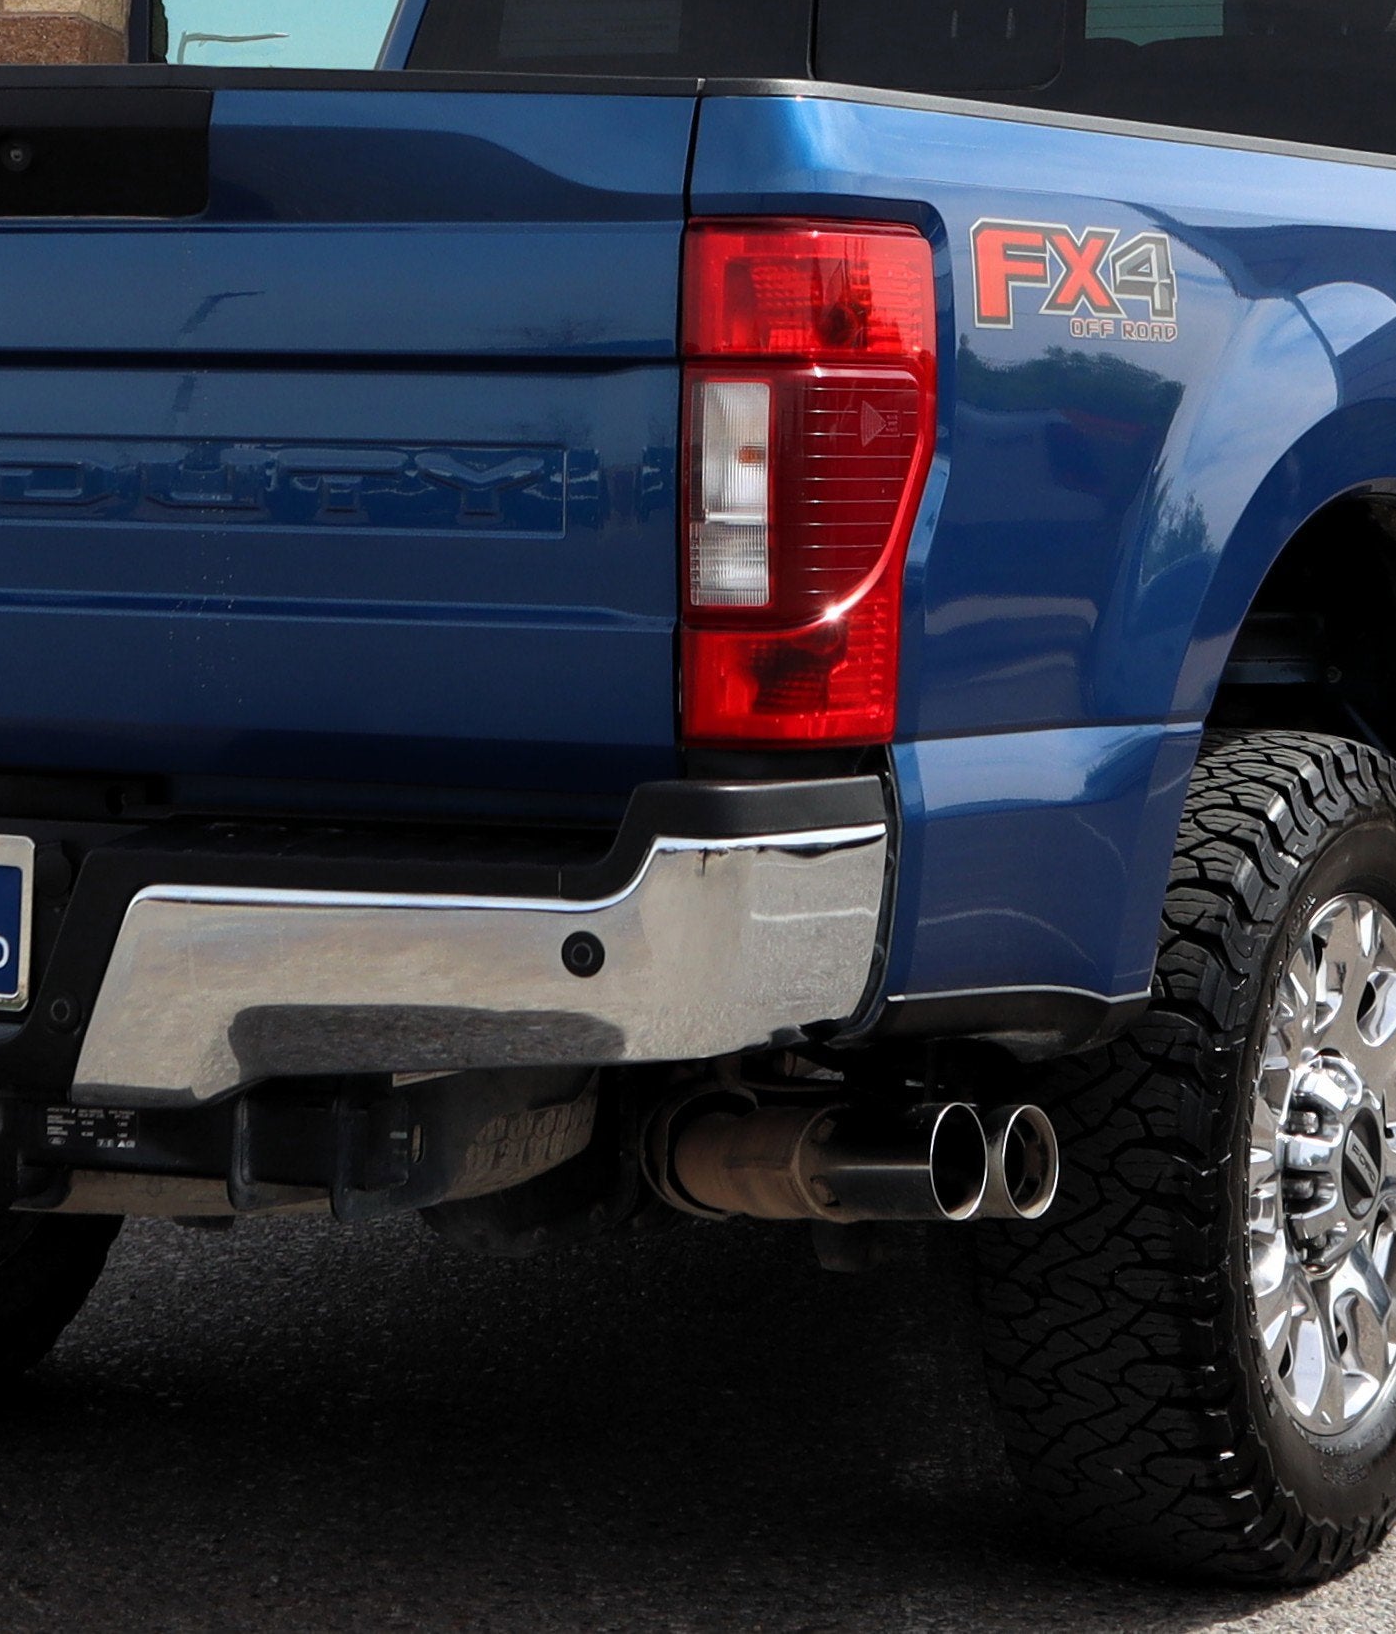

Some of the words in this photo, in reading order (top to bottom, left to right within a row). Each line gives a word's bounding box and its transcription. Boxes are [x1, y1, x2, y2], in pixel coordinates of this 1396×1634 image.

[970, 218, 1178, 330] FX4
[1070, 318, 1115, 339] OFF
[1121, 322, 1178, 343] ROAD
[1351, 1142, 1377, 1184] FORD
